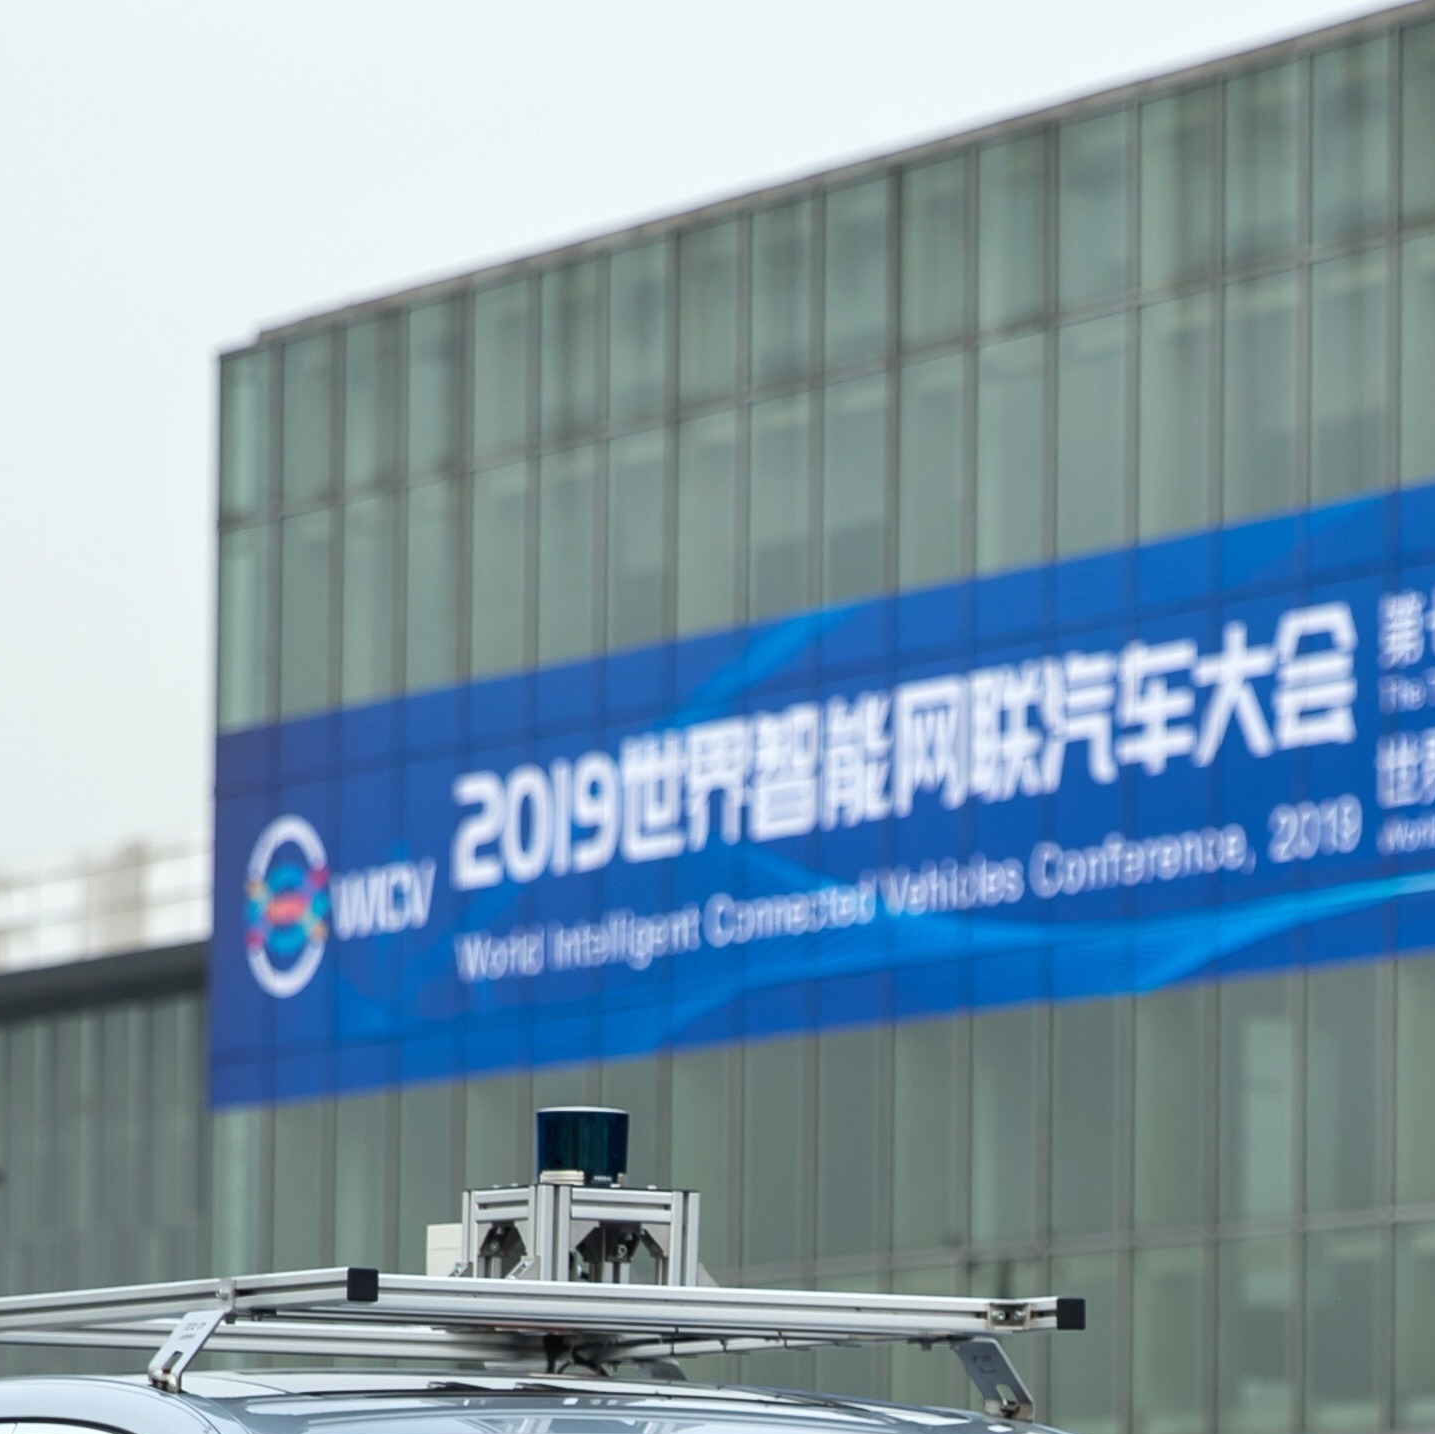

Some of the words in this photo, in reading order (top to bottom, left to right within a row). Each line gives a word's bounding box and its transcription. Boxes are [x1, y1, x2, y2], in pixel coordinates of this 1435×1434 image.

[450, 600, 1359, 892] 2019世界智能网联汽车大会
[329, 858, 436, 941] WICV
[455, 923, 545, 983] World
[551, 905, 703, 971] Intelligent
[704, 875, 876, 948] Connected
[878, 852, 1025, 916] Vehicles
[1268, 795, 1363, 864] 2019
